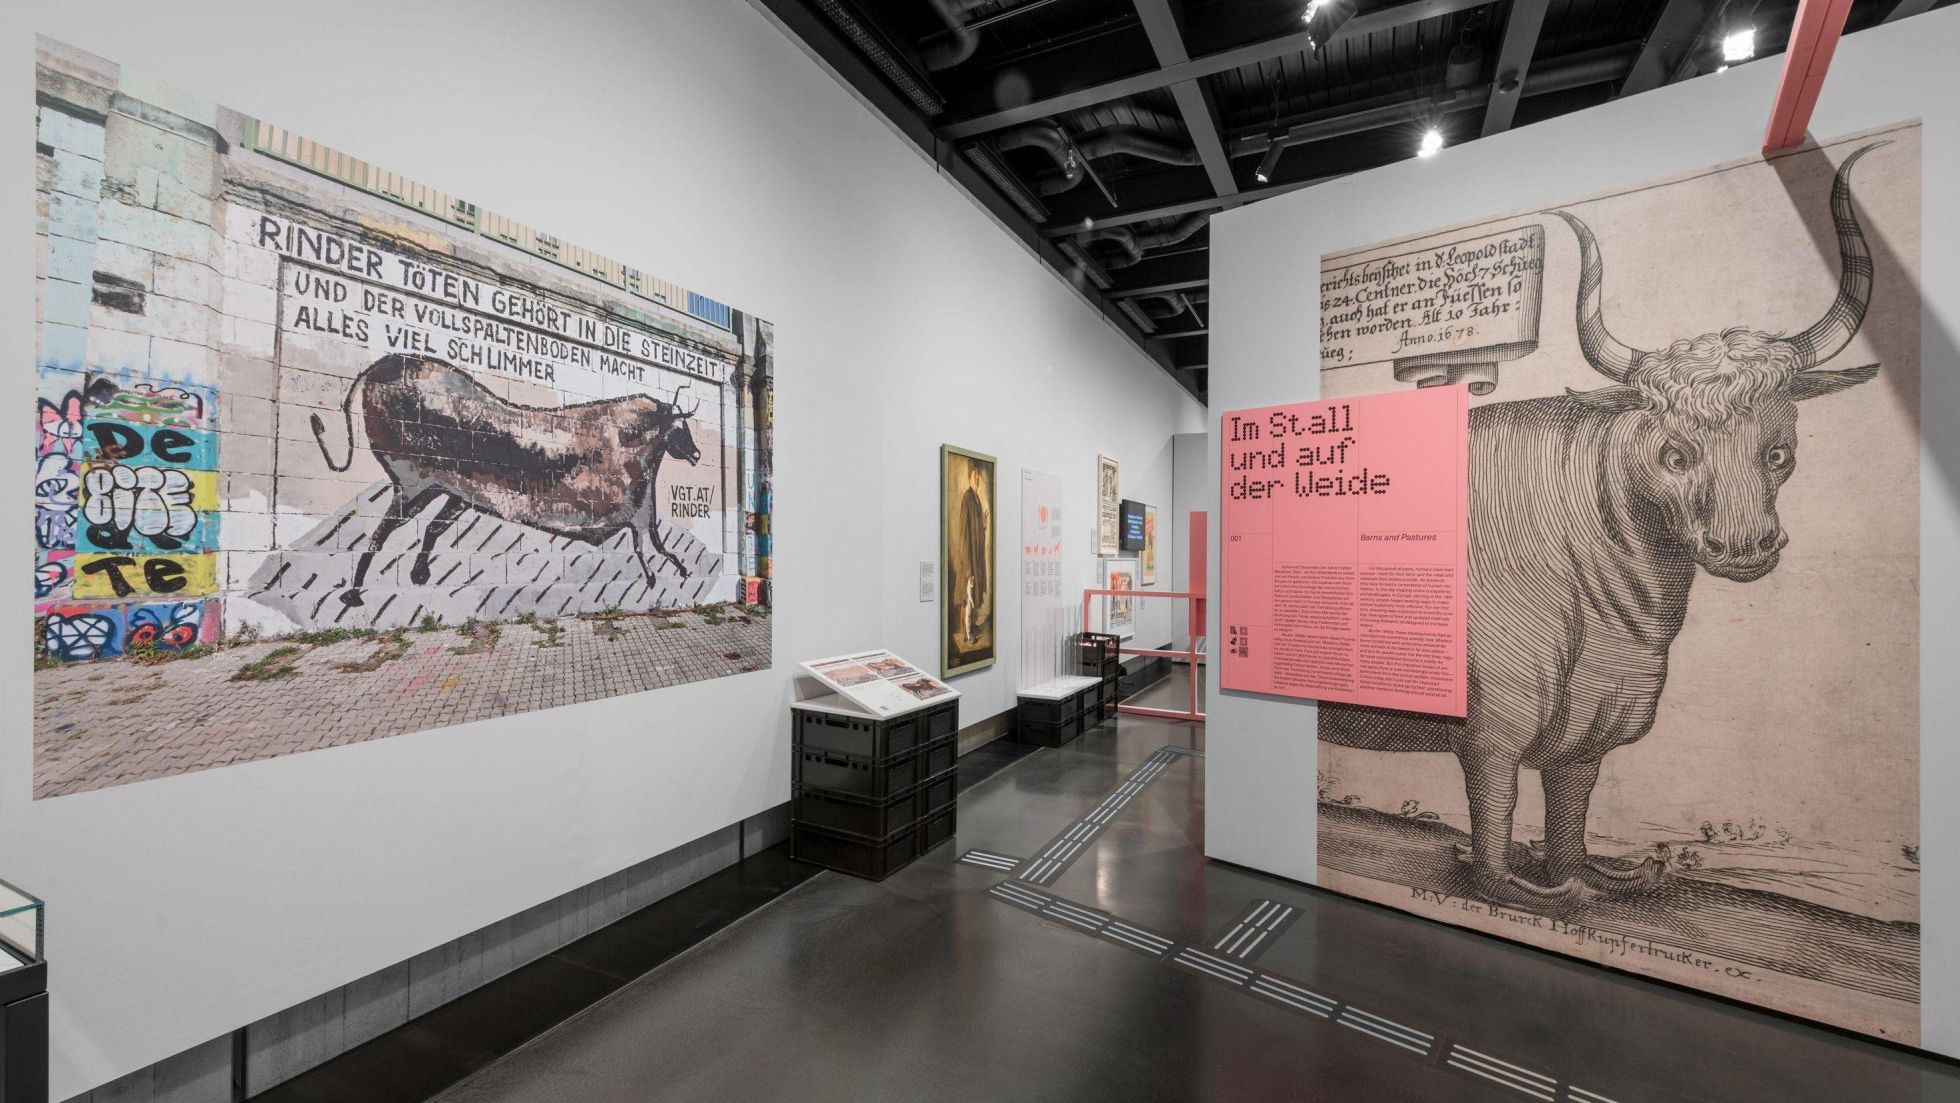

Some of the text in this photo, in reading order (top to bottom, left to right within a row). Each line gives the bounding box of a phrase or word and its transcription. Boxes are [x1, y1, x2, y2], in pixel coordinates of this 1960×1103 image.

[1415, 256, 1433, 272] in
[259, 215, 383, 279] RINDER
[399, 259, 480, 306] TÖTEN
[492, 290, 571, 333] GEHÖRT
[579, 317, 596, 342] IN
[604, 325, 631, 353] DIE
[1418, 272, 1441, 291] die
[294, 305, 555, 382] ALLES VIEL SCHLIMMER
[295, 271, 645, 382] UND DER VOLLSPALTENBODEN MACHT
[1231, 404, 1354, 442] Im Stall
[86, 422, 195, 464] De
[1230, 436, 1356, 471] und auf
[670, 484, 715, 505] VGT.AT/
[1230, 467, 1391, 500] der Weide
[671, 502, 711, 519] RINDER
[1360, 533, 1437, 542] Barns and Pastures
[81, 556, 188, 597] Te
[1462, 899, 1482, 913] der
